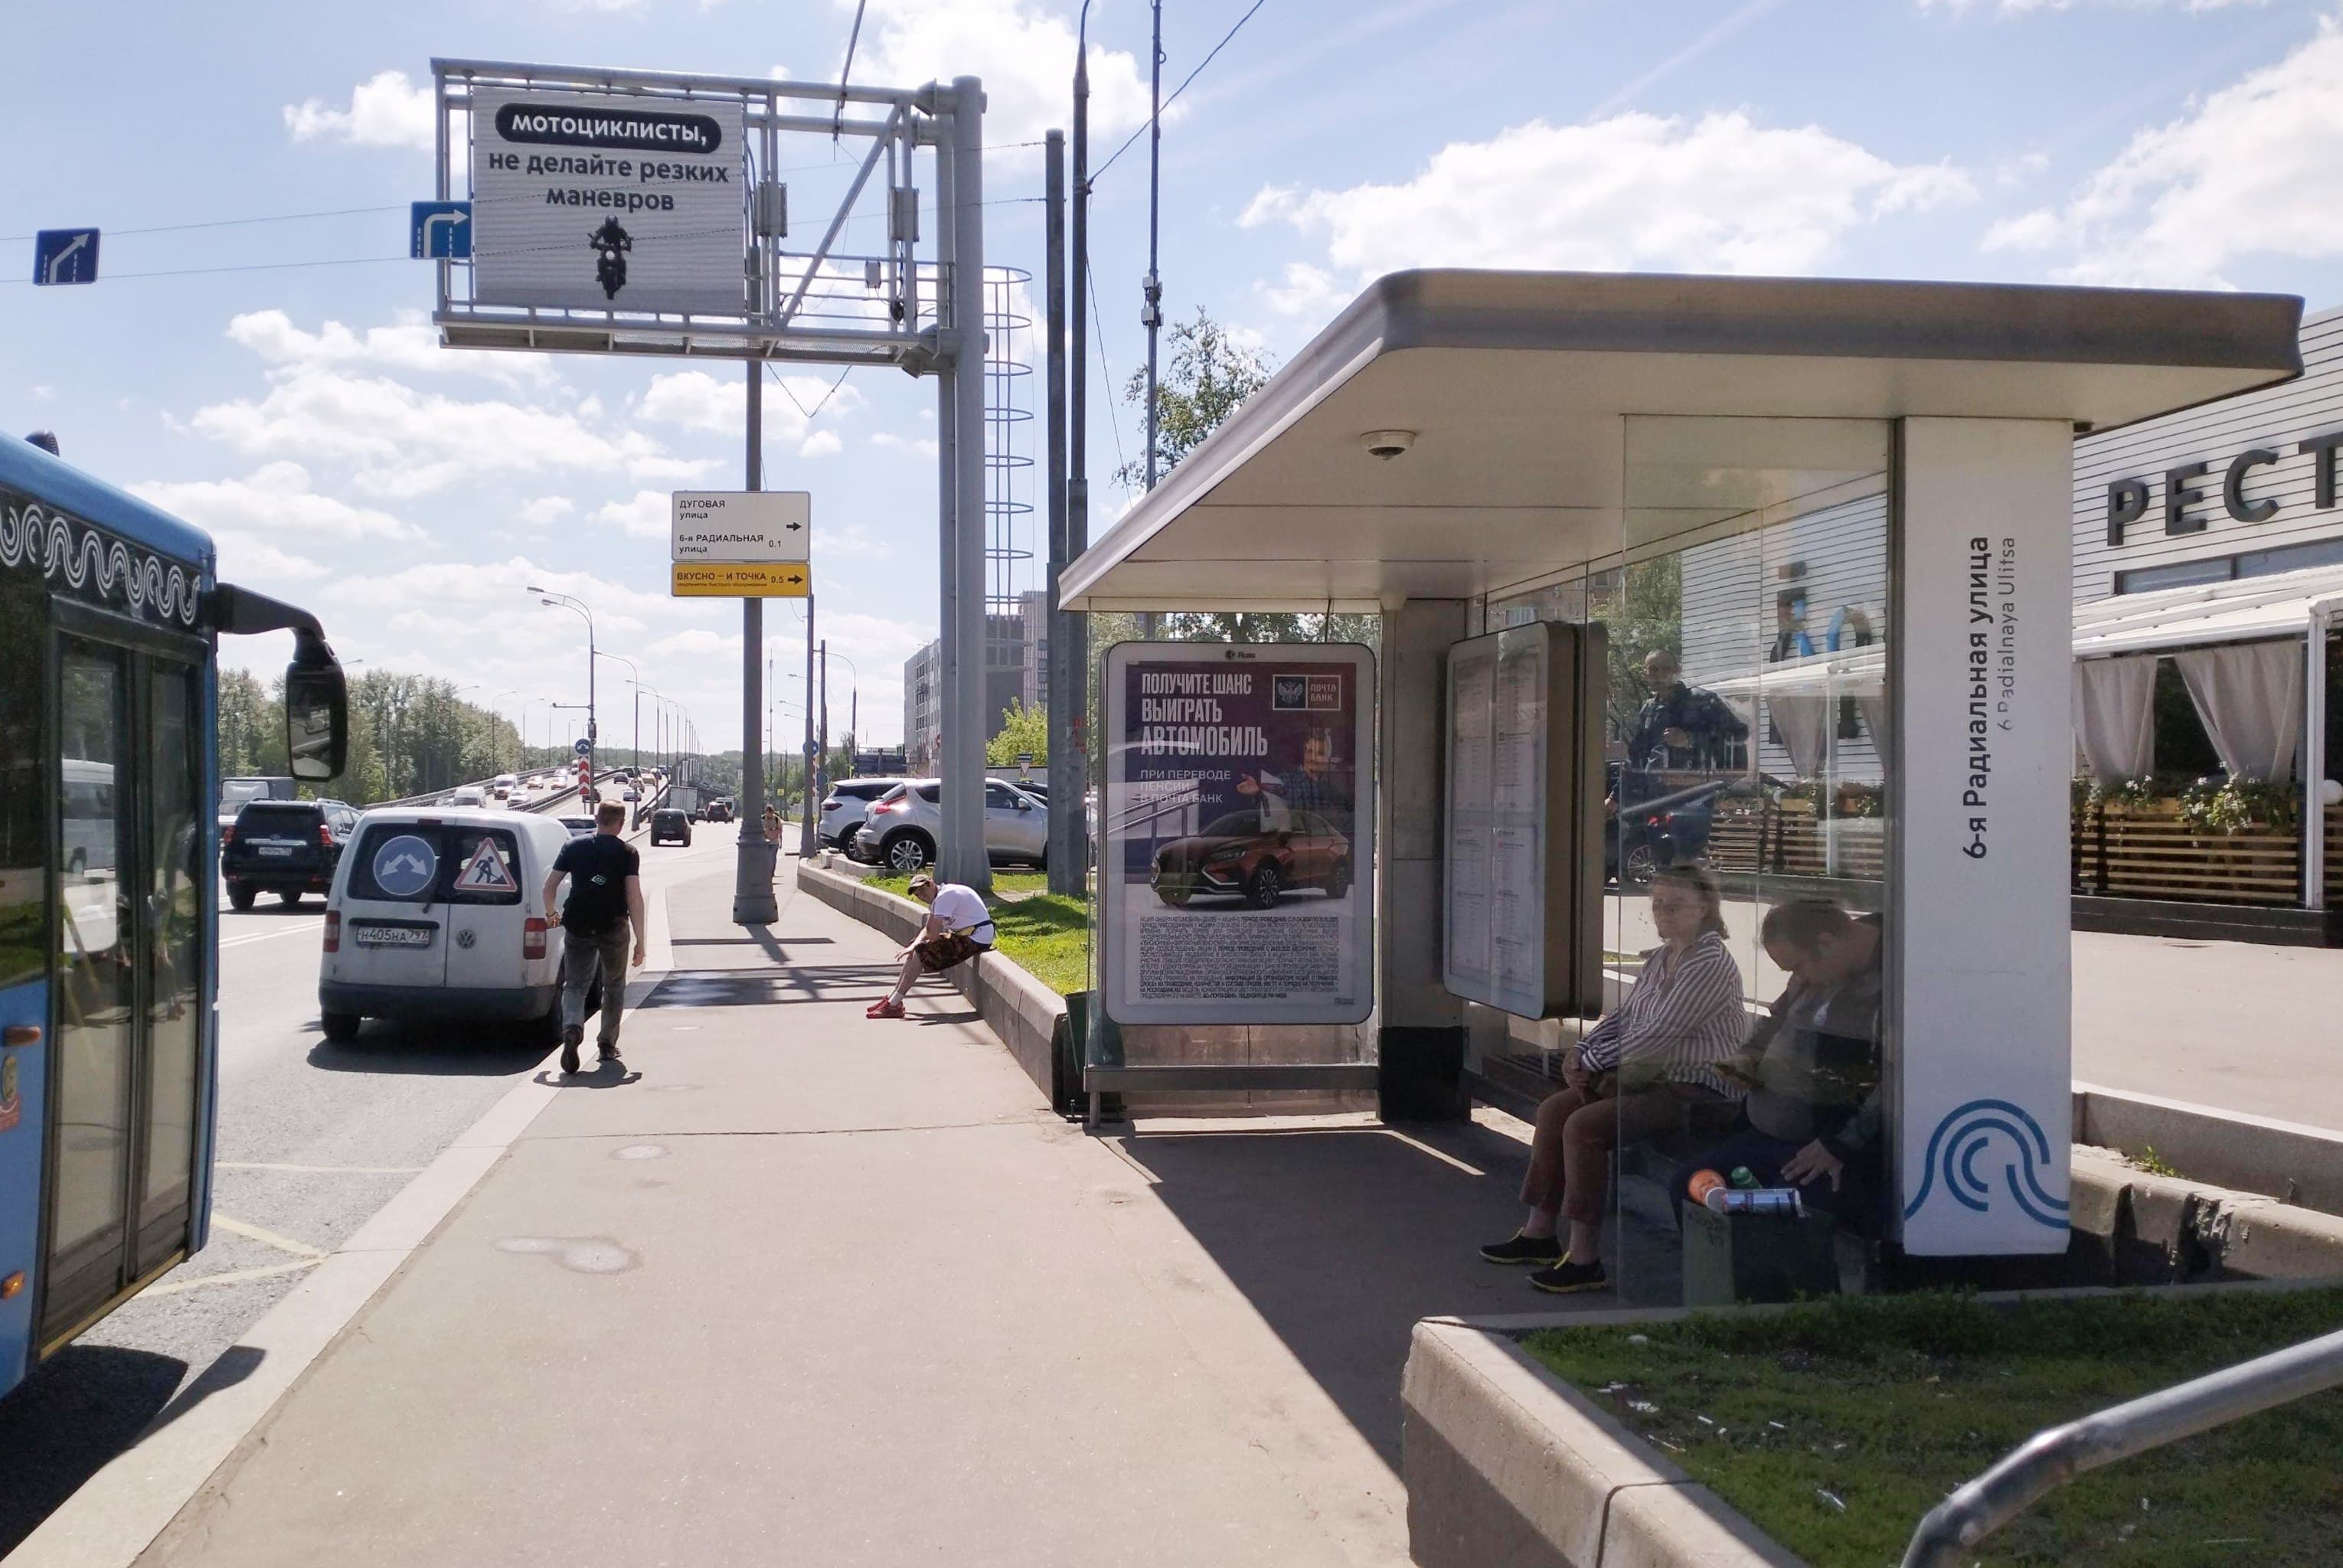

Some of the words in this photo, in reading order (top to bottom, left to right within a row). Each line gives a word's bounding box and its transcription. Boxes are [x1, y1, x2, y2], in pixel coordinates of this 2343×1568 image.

[489, 152, 520, 170] не
[526, 154, 632, 176] делайте
[640, 161, 729, 183] резких
[546, 188, 675, 214] маневров
[2107, 432, 2343, 546] РЕСТ
[679, 500, 726, 509] ДУГОВАЯ
[680, 512, 708, 521] улица
[679, 546, 708, 554] улица
[696, 534, 764, 543] РАДИАЛЬНАЯ
[769, 540, 782, 548] 0.1
[677, 572, 715, 580] ВКУСНО
[726, 572, 733, 580] И
[736, 572, 766, 580] ТОЧКА
[771, 575, 784, 583] 0.5
[1997, 537, 2015, 595] Ulitsa
[1969, 537, 1994, 623] улица
[1997, 602, 2018, 713] Radialnaya
[1142, 674, 1211, 694] ПОЛУЧИТЕ
[1213, 674, 1253, 694] ШАНС
[1310, 693, 1333, 702] БАНК
[1142, 697, 1223, 723] ВЫИГРАТЬ
[1962, 632, 1992, 807] Радиальная
[1141, 726, 1269, 756] АВТОМОБИЛЬ
[1140, 769, 1164, 779] ПРИ
[1168, 769, 1231, 781] ПЕРЕВОДЕ
[1140, 782, 1190, 791] ПЕНСИИ
[1192, 793, 1224, 803] БАНК
[1962, 817, 1988, 859] 6-я
